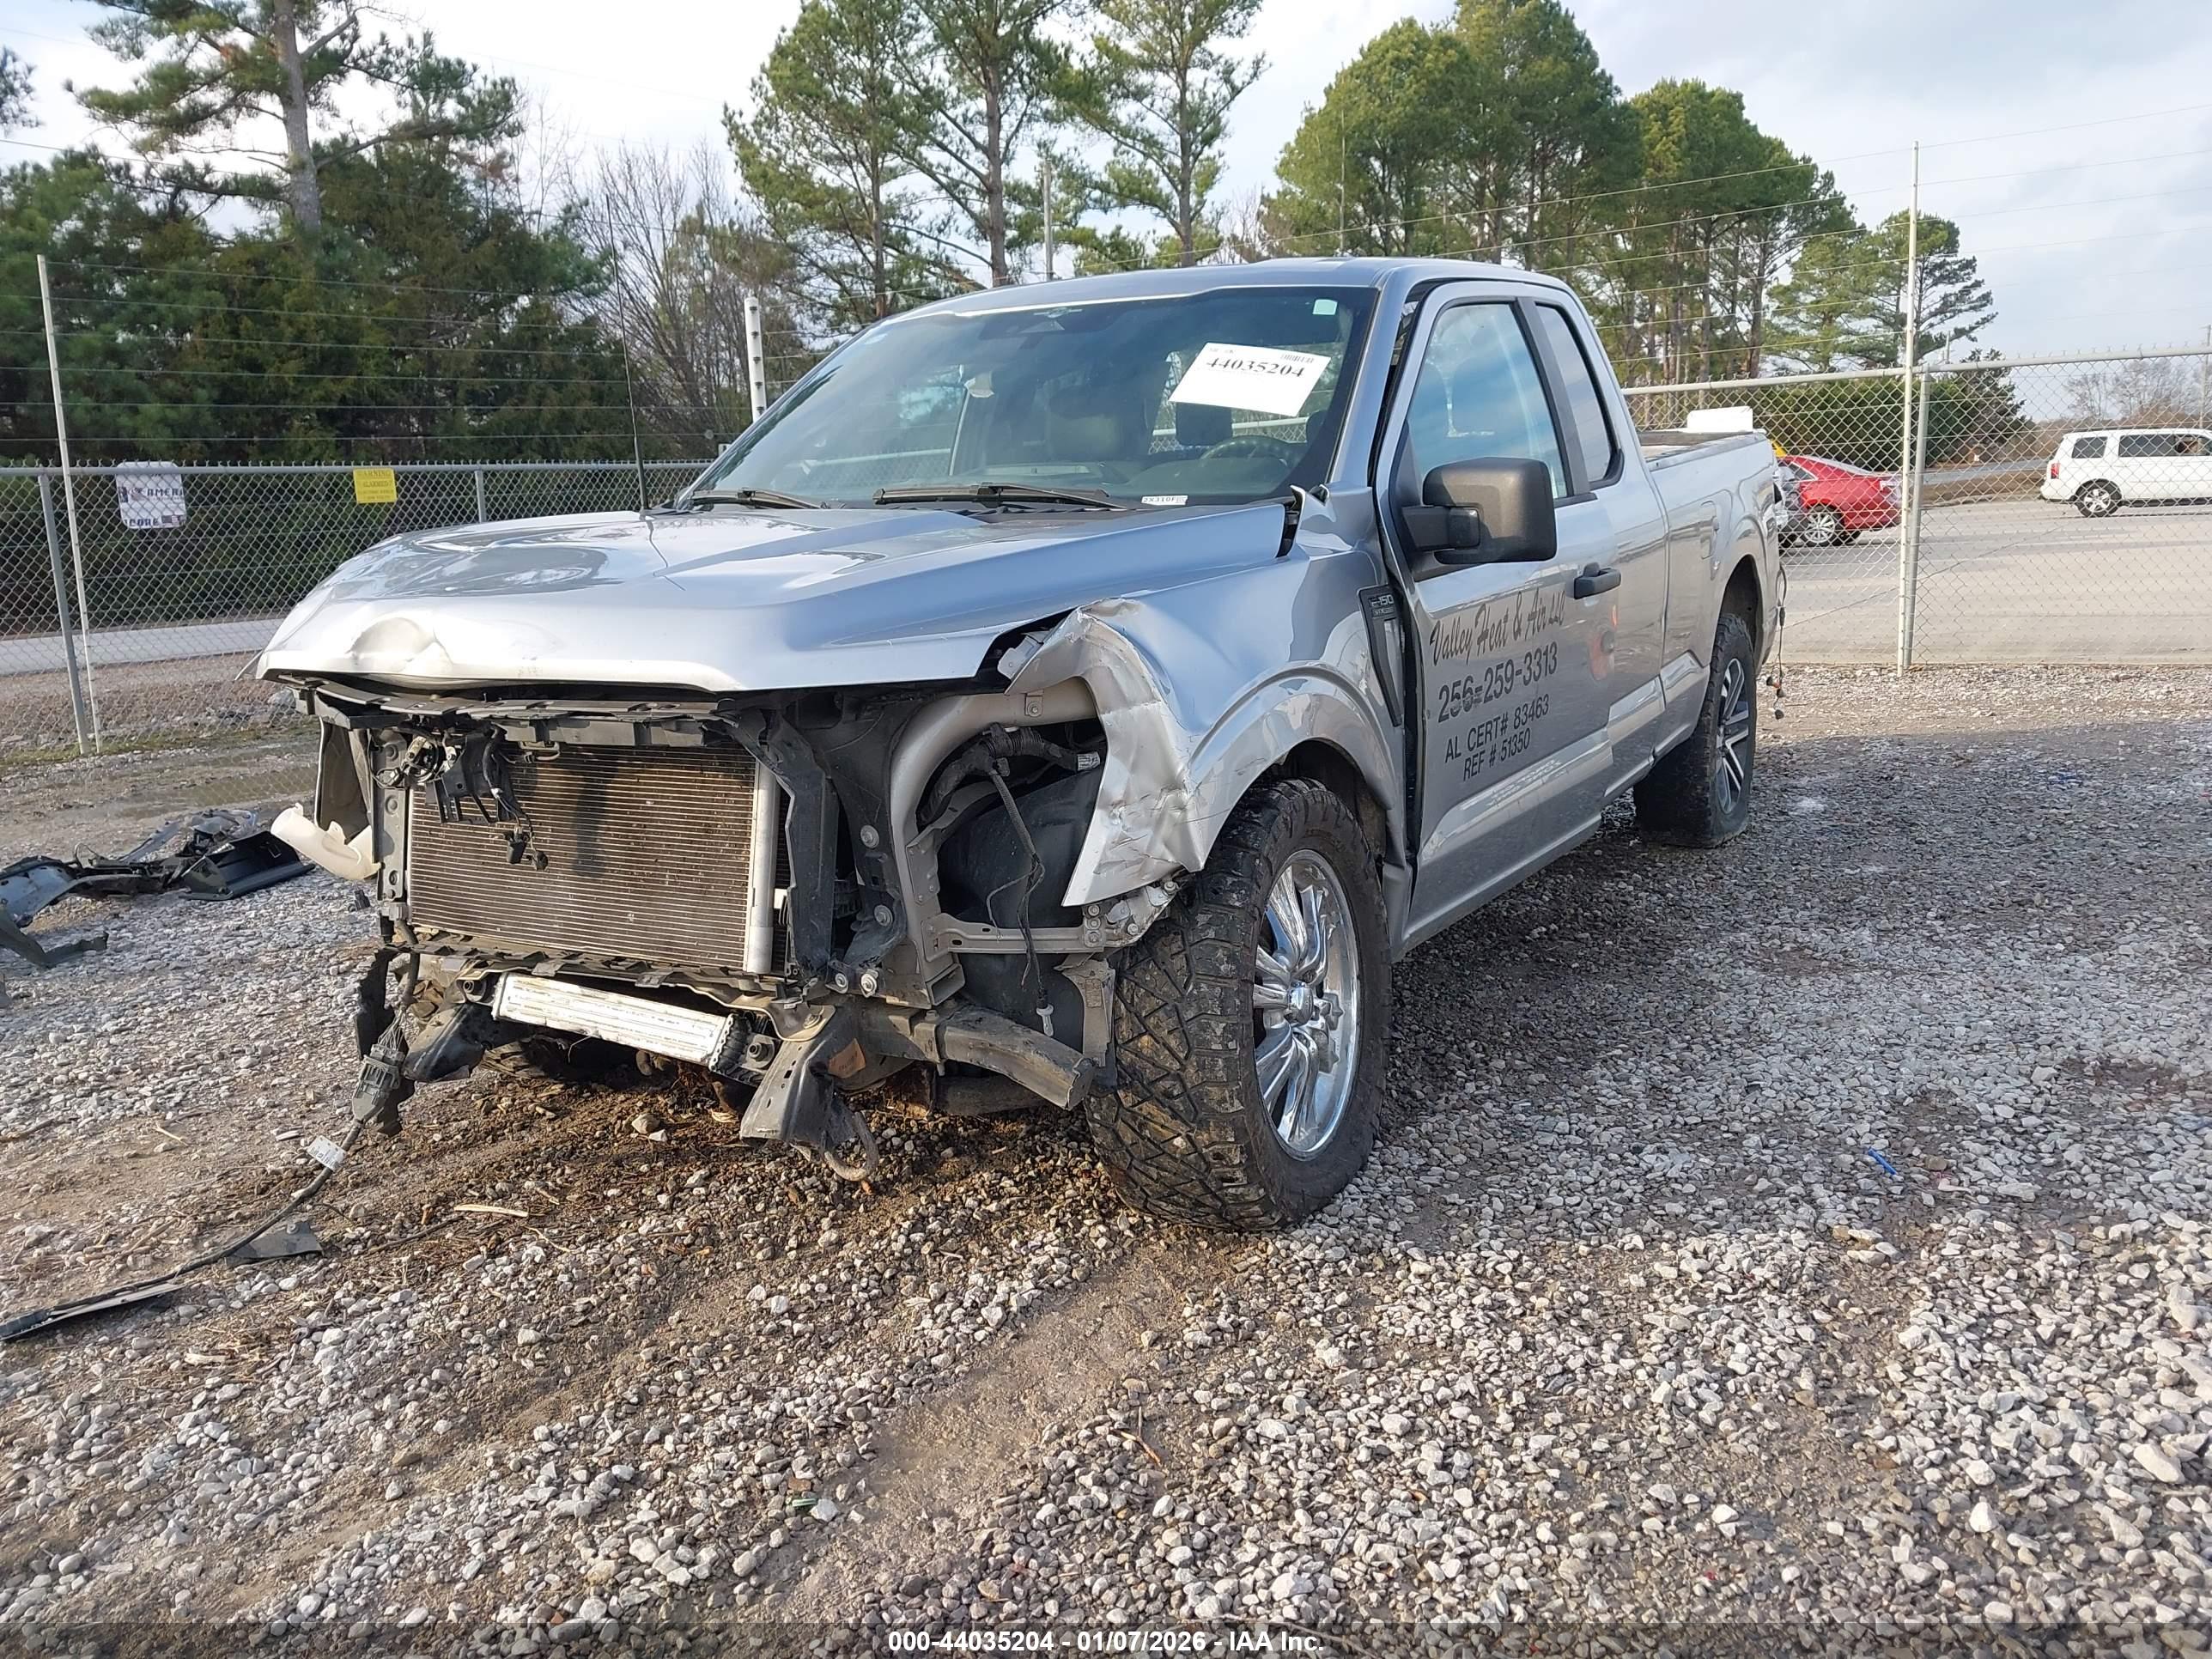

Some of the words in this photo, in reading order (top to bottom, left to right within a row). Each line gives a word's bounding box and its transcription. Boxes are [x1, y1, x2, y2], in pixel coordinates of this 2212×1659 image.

[1206, 357, 1305, 378] 44035204
[1430, 616, 1473, 666] Valley
[1474, 603, 1509, 657] Heat
[1513, 591, 1522, 641] &
[1524, 586, 1547, 641] Air
[1437, 641, 1558, 723] 256-259-3313
[1445, 735, 1462, 763] AL
[1467, 711, 1509, 752] CERT#
[1513, 693, 1549, 730] 83463
[1463, 749, 1486, 781] REF
[1489, 743, 1497, 768] #
[1500, 727, 1531, 762] 51350
